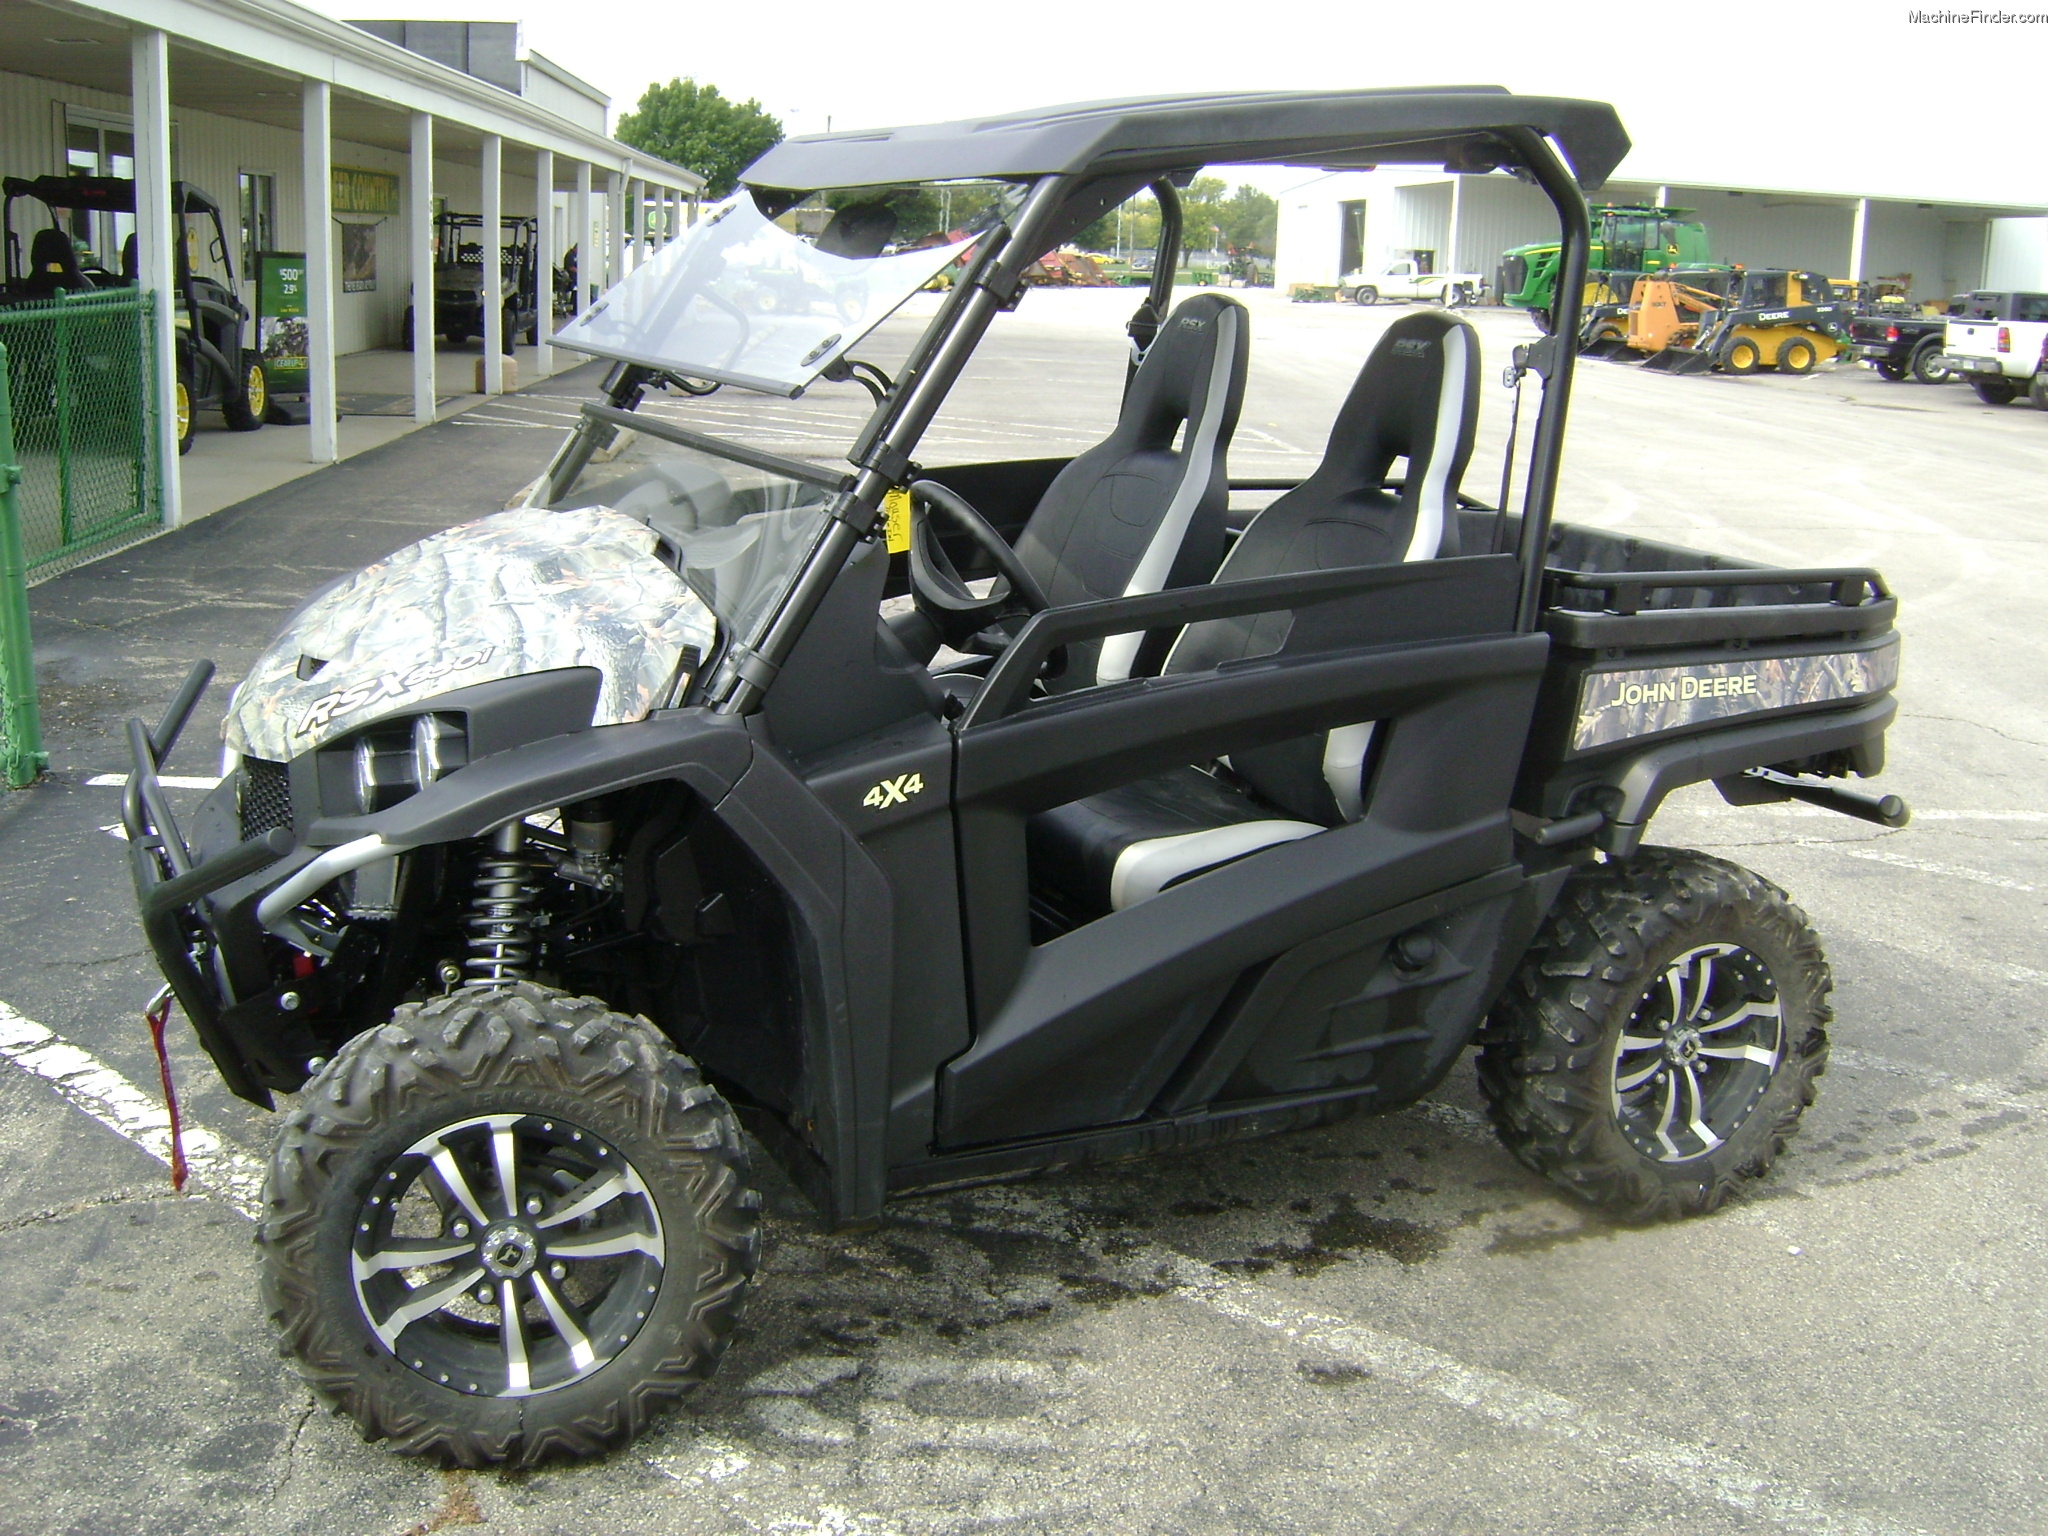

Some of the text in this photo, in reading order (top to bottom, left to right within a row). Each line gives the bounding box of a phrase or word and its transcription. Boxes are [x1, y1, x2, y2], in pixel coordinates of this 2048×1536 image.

[332, 171, 350, 209] EER
[1758, 310, 1791, 322] DEERE
[1611, 674, 1757, 707] JOHN DEERE
[863, 772, 924, 810] 4X4
